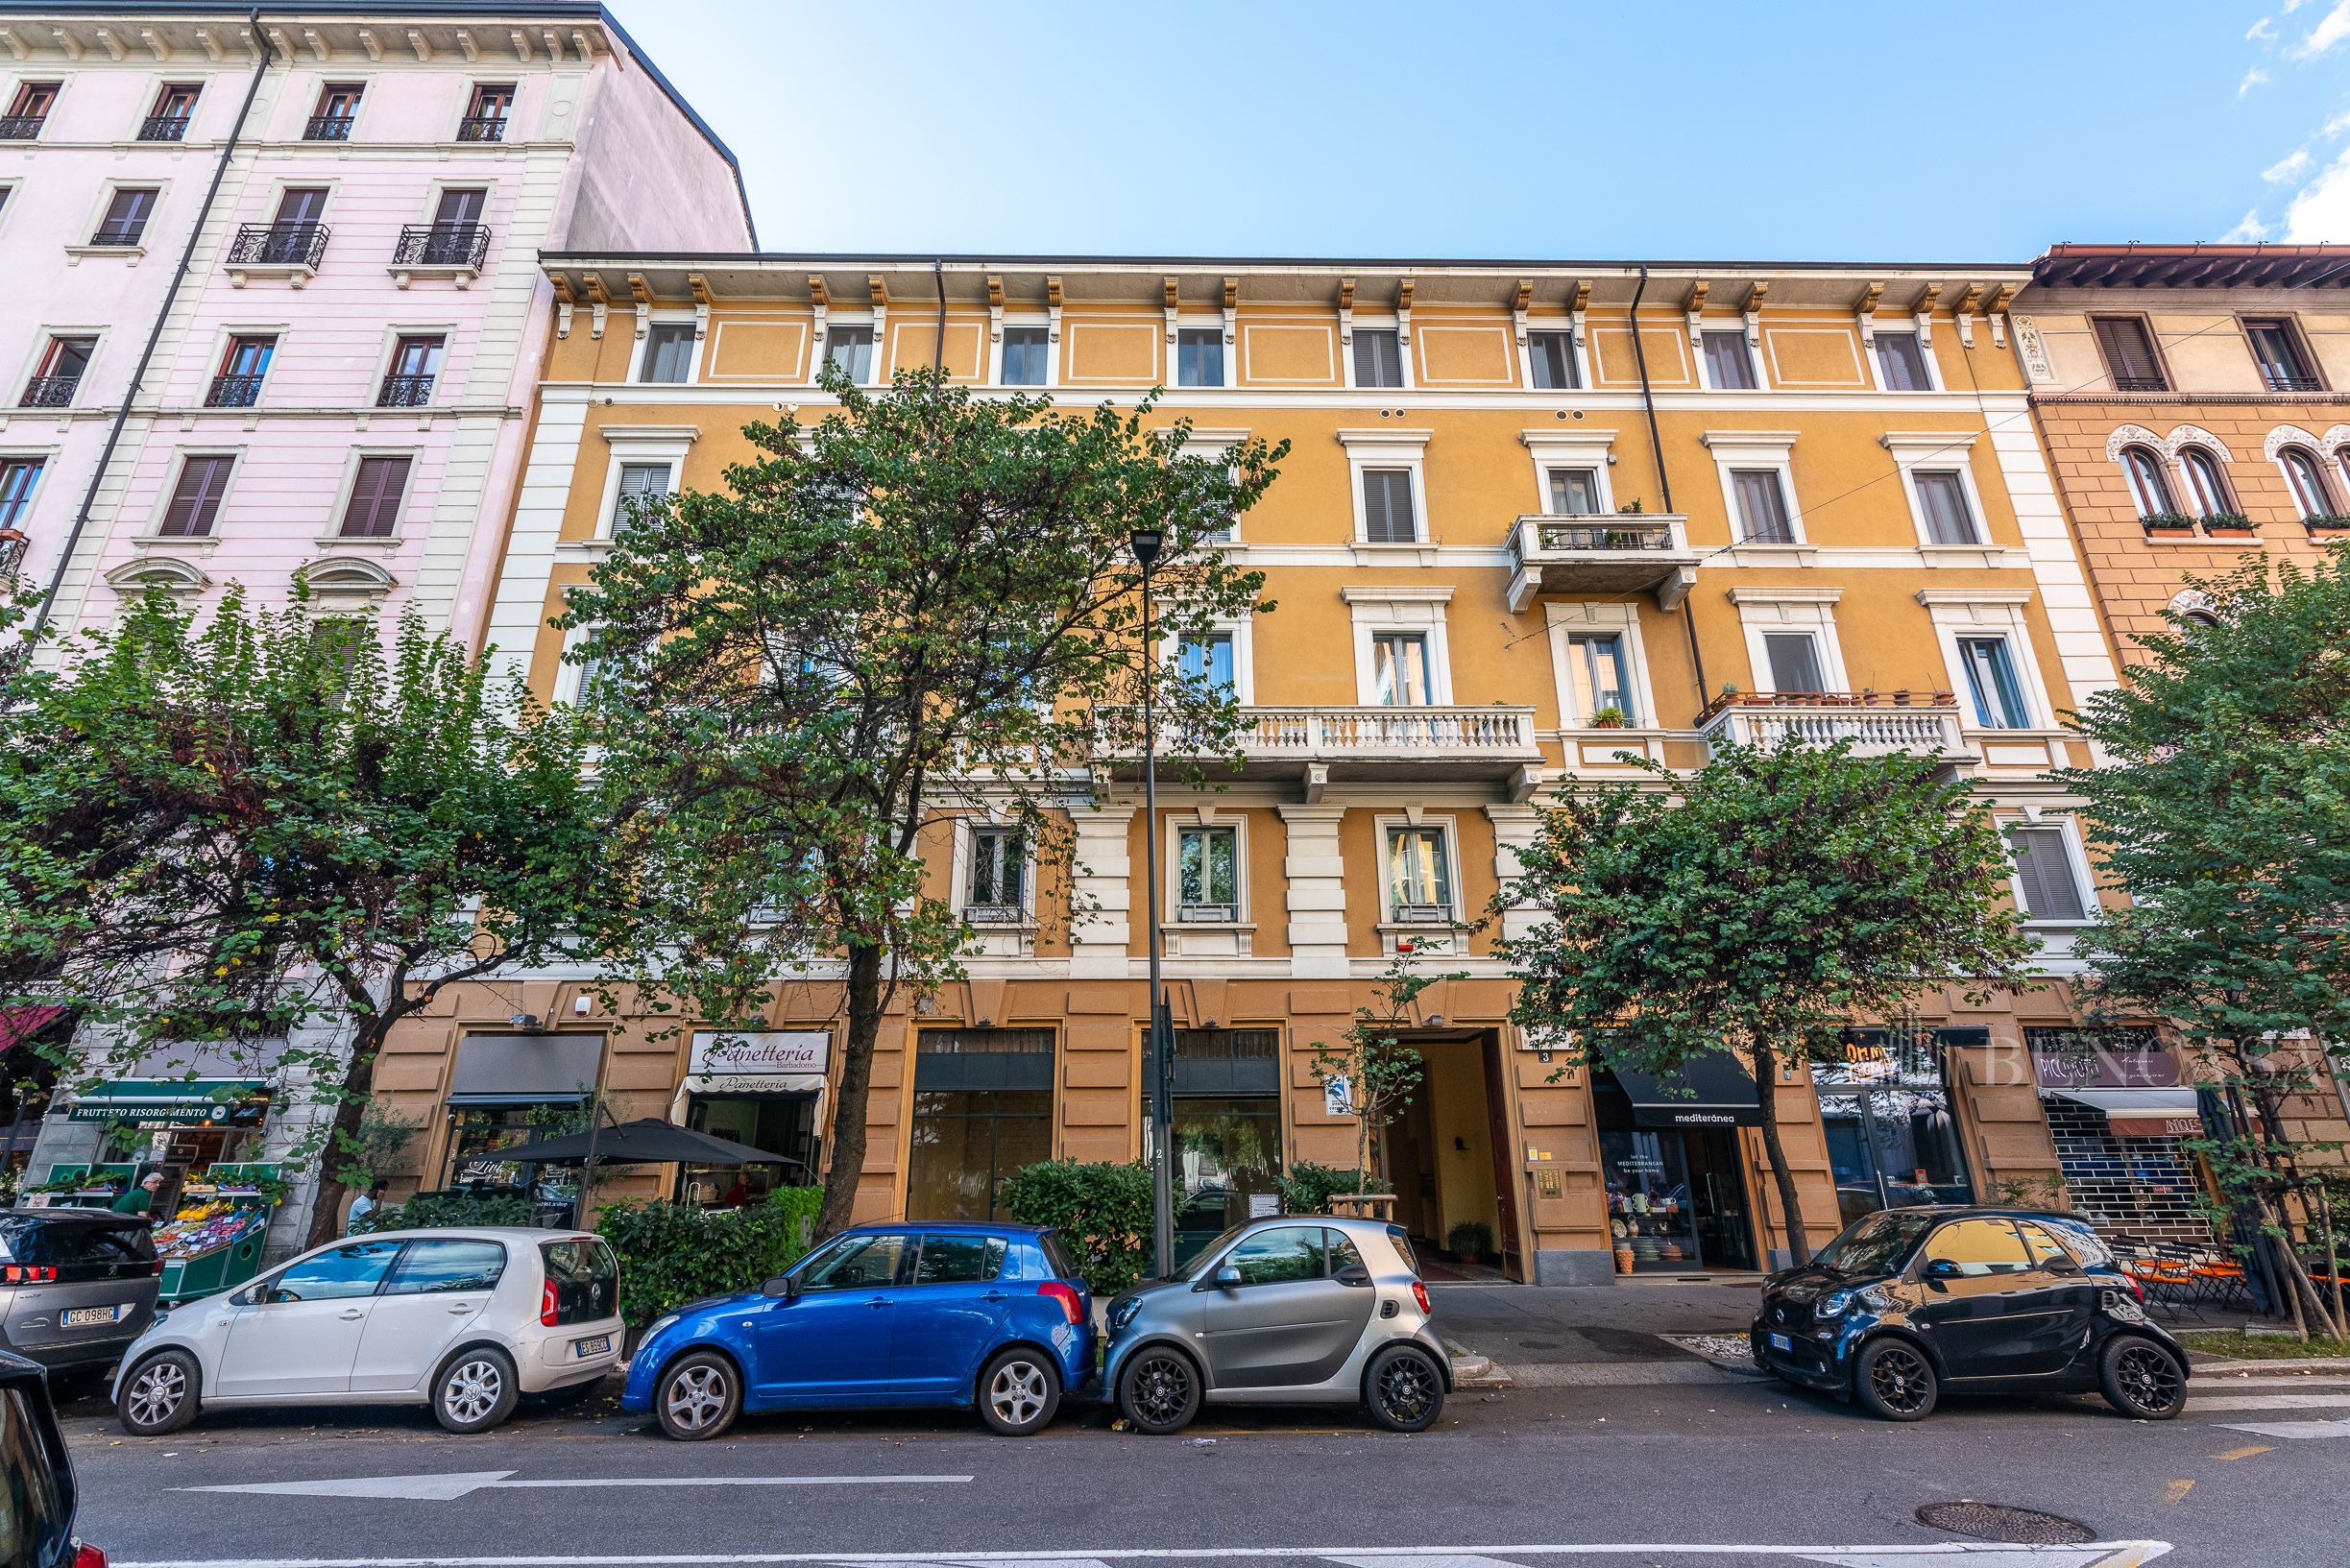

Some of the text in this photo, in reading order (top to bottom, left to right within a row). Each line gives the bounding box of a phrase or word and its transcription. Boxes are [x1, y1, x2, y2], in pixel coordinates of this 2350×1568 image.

[702, 1041, 814, 1062] Panetteria
[1542, 1052, 1549, 1062] 3
[720, 1076, 787, 1089] Panetteria
[1156, 1149, 1162, 1159] 2
